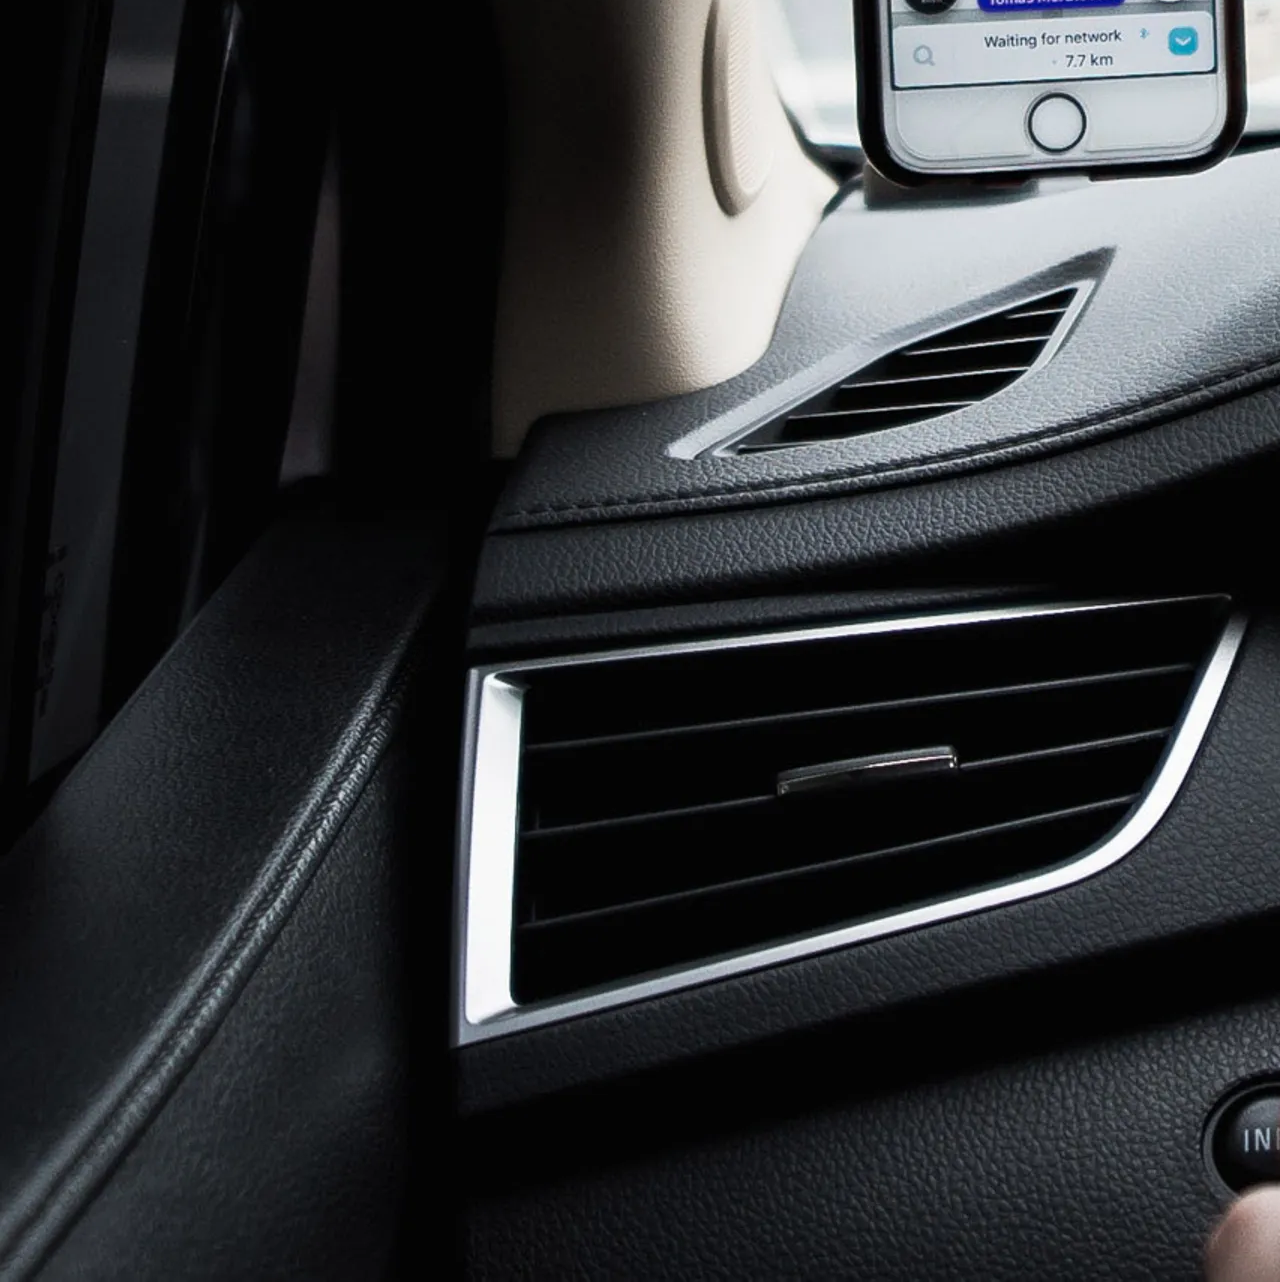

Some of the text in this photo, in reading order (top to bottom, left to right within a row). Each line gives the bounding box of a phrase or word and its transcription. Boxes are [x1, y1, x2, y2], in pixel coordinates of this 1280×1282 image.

[984, 29, 1122, 49] Waiting for network
[1065, 53, 1114, 67] 7.7 km
